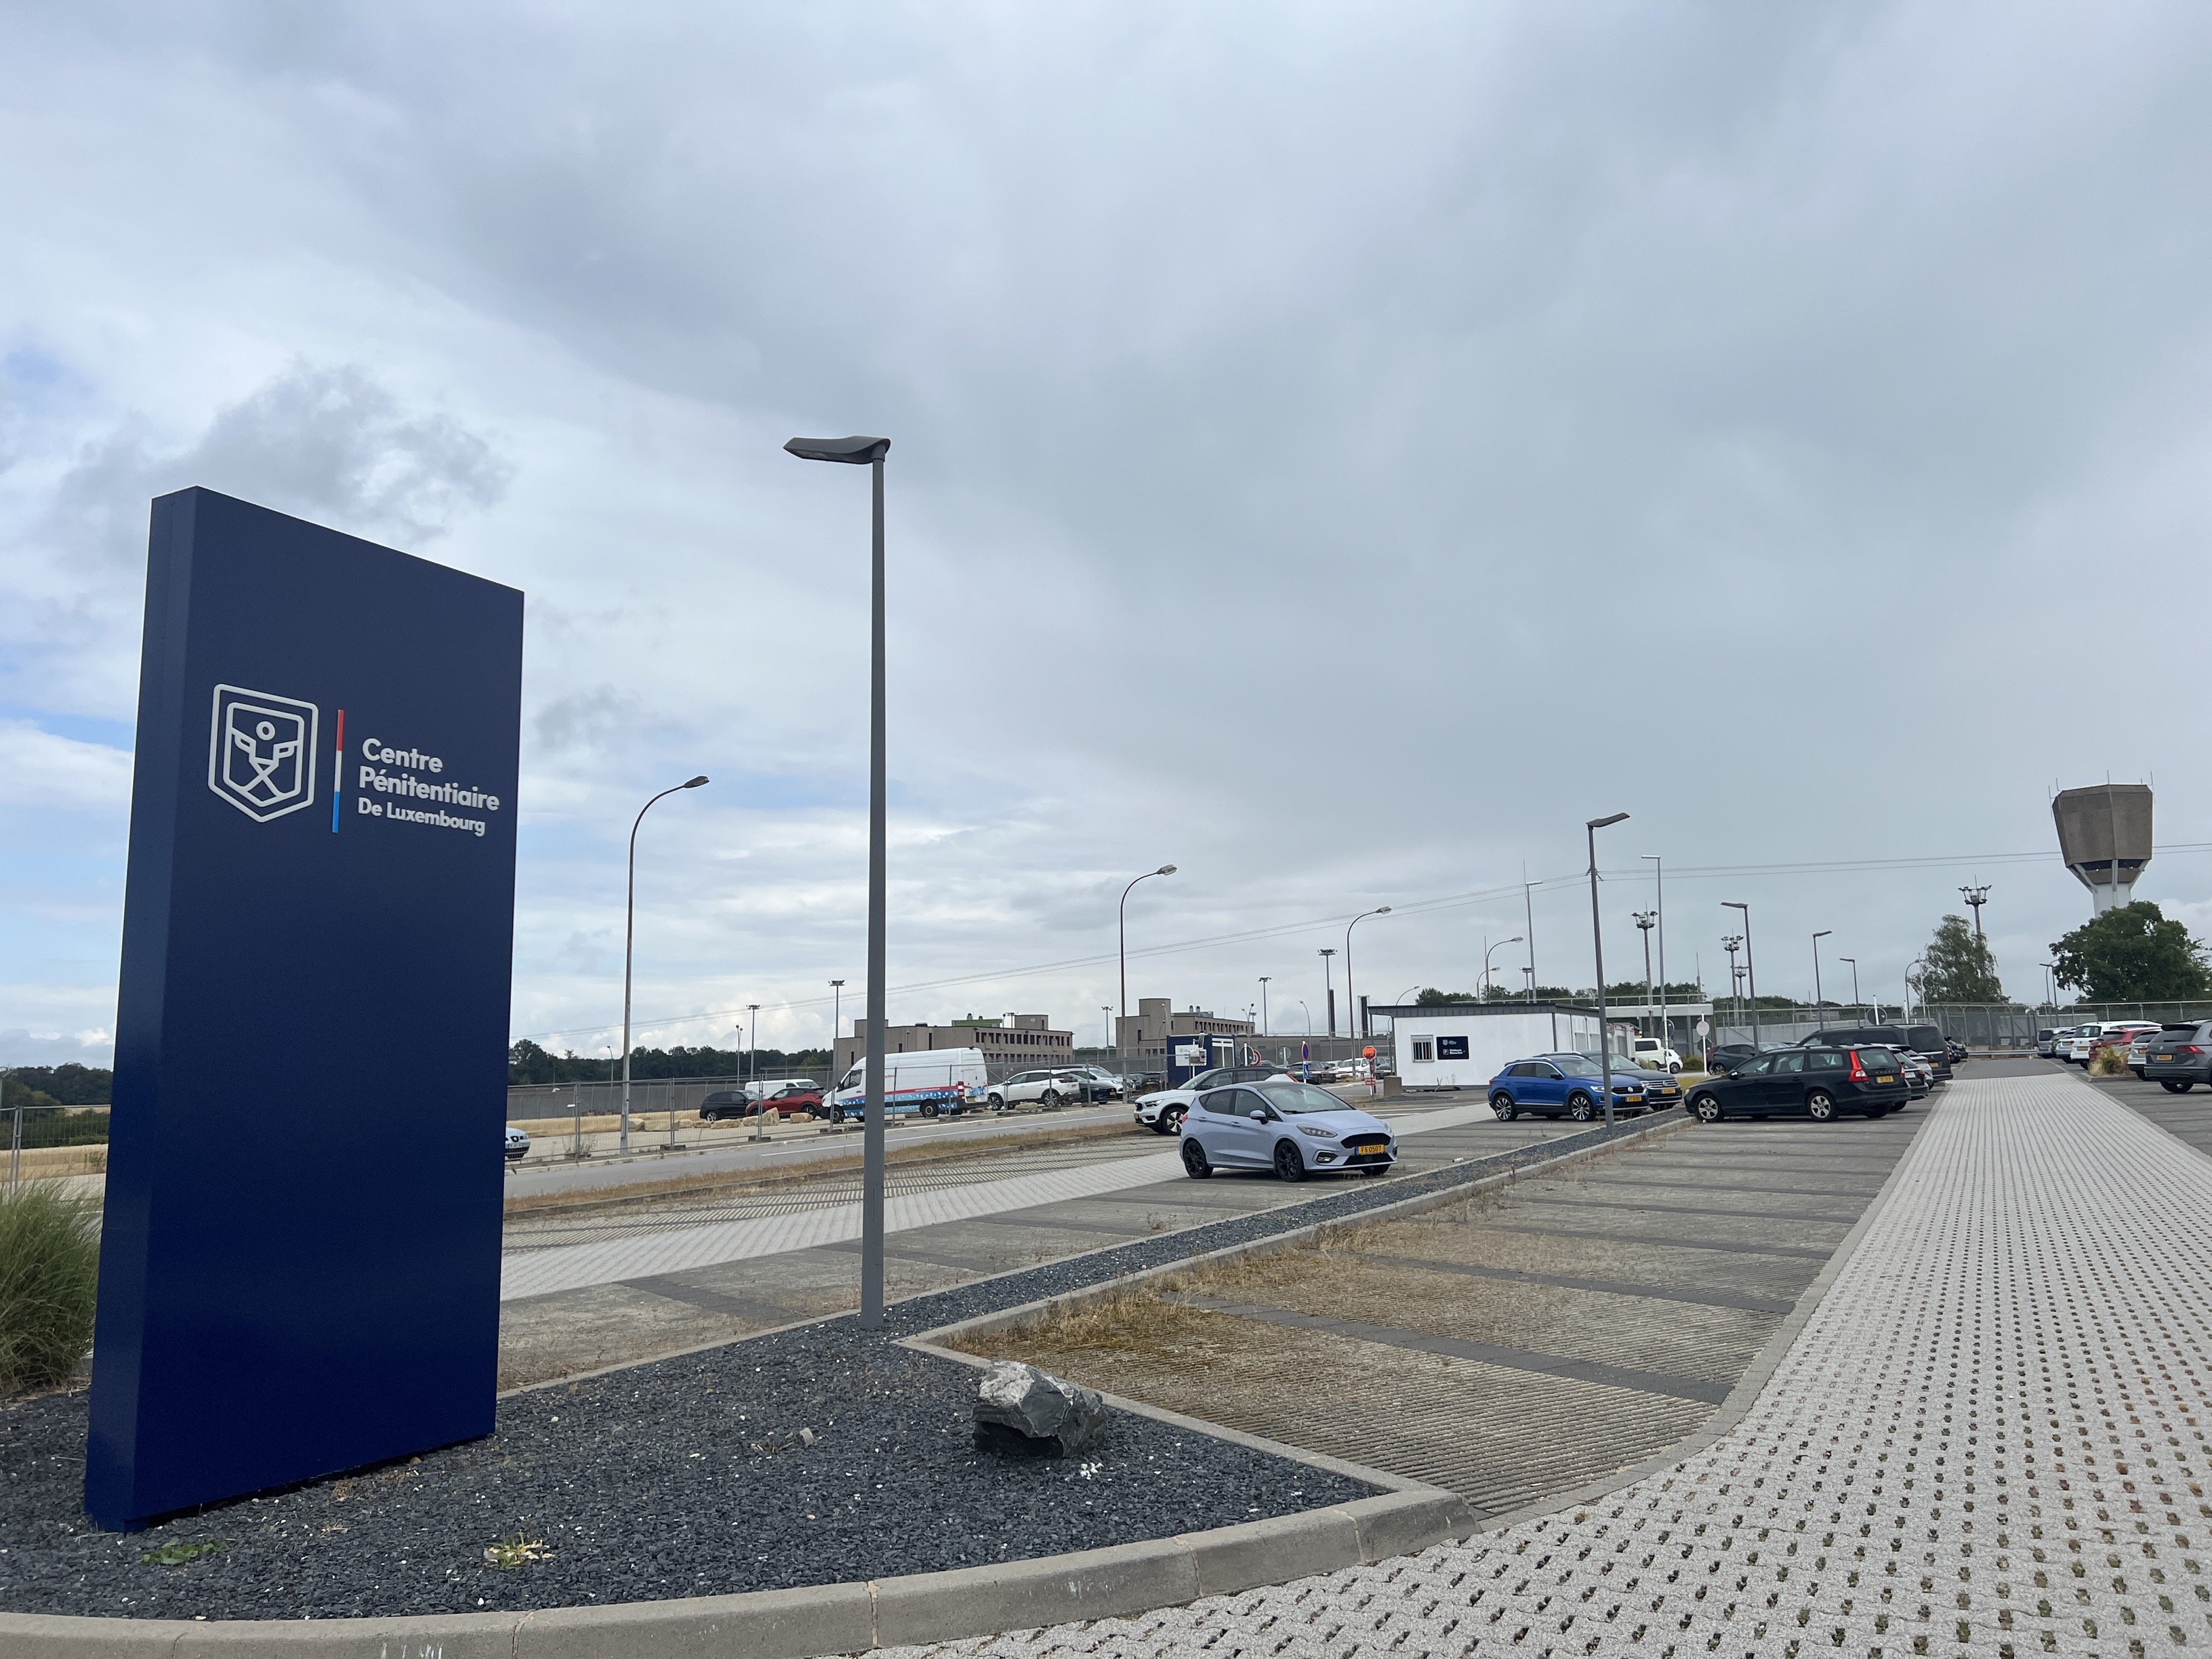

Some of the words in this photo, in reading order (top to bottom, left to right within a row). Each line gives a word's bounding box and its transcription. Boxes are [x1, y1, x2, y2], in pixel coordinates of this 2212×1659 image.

[362, 738, 443, 773] Centre
[359, 765, 500, 811] Pénitentiaire
[358, 797, 382, 817] De
[386, 802, 486, 837] Luxembourg
